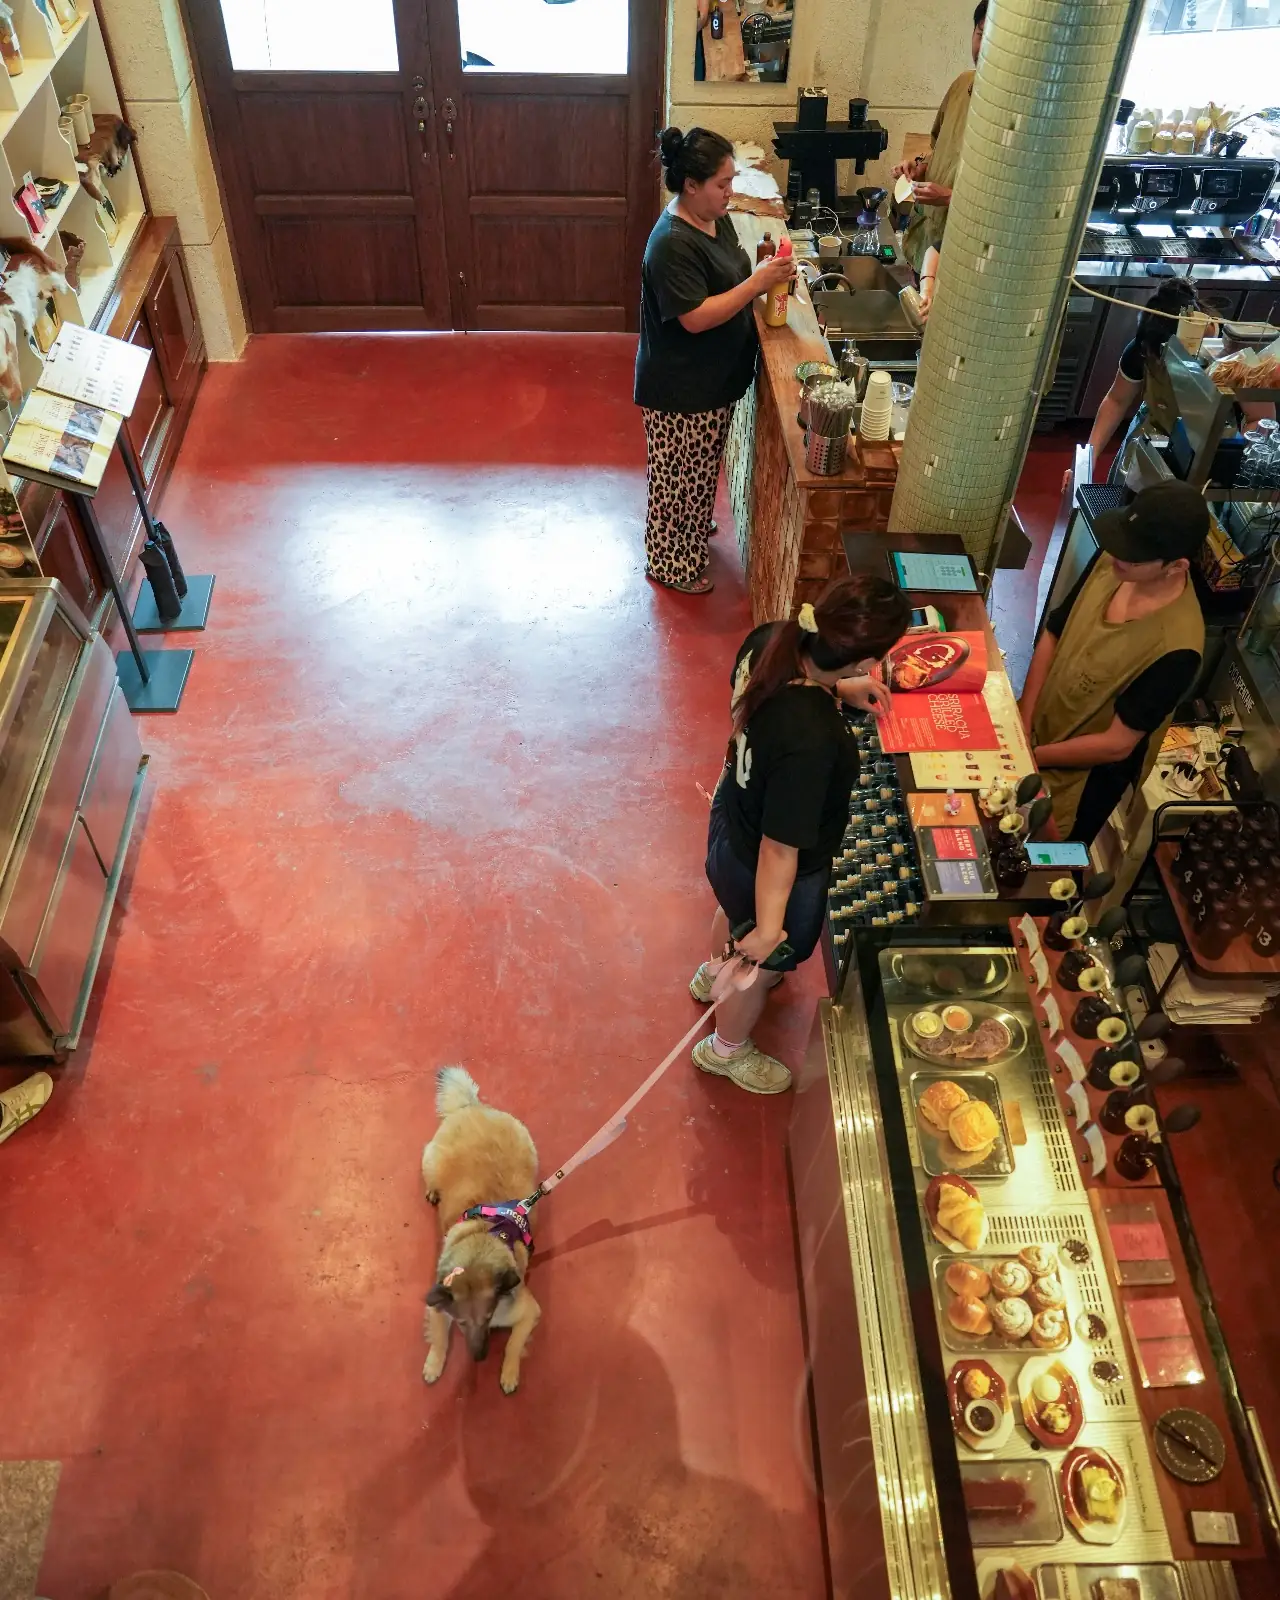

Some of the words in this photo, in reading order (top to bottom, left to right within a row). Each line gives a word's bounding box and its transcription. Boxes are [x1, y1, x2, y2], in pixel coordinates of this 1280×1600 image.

[927, 693, 947, 731] CHEESE
[938, 693, 958, 733] GRILLED
[948, 693, 971, 740] SRIRACHA
[954, 829, 966, 851] BLEND
[960, 828, 974, 857] LIBERTY
[959, 862, 971, 885] BLEND
[966, 862, 977, 880] BLUE
[1256, 926, 1272, 947] 13
